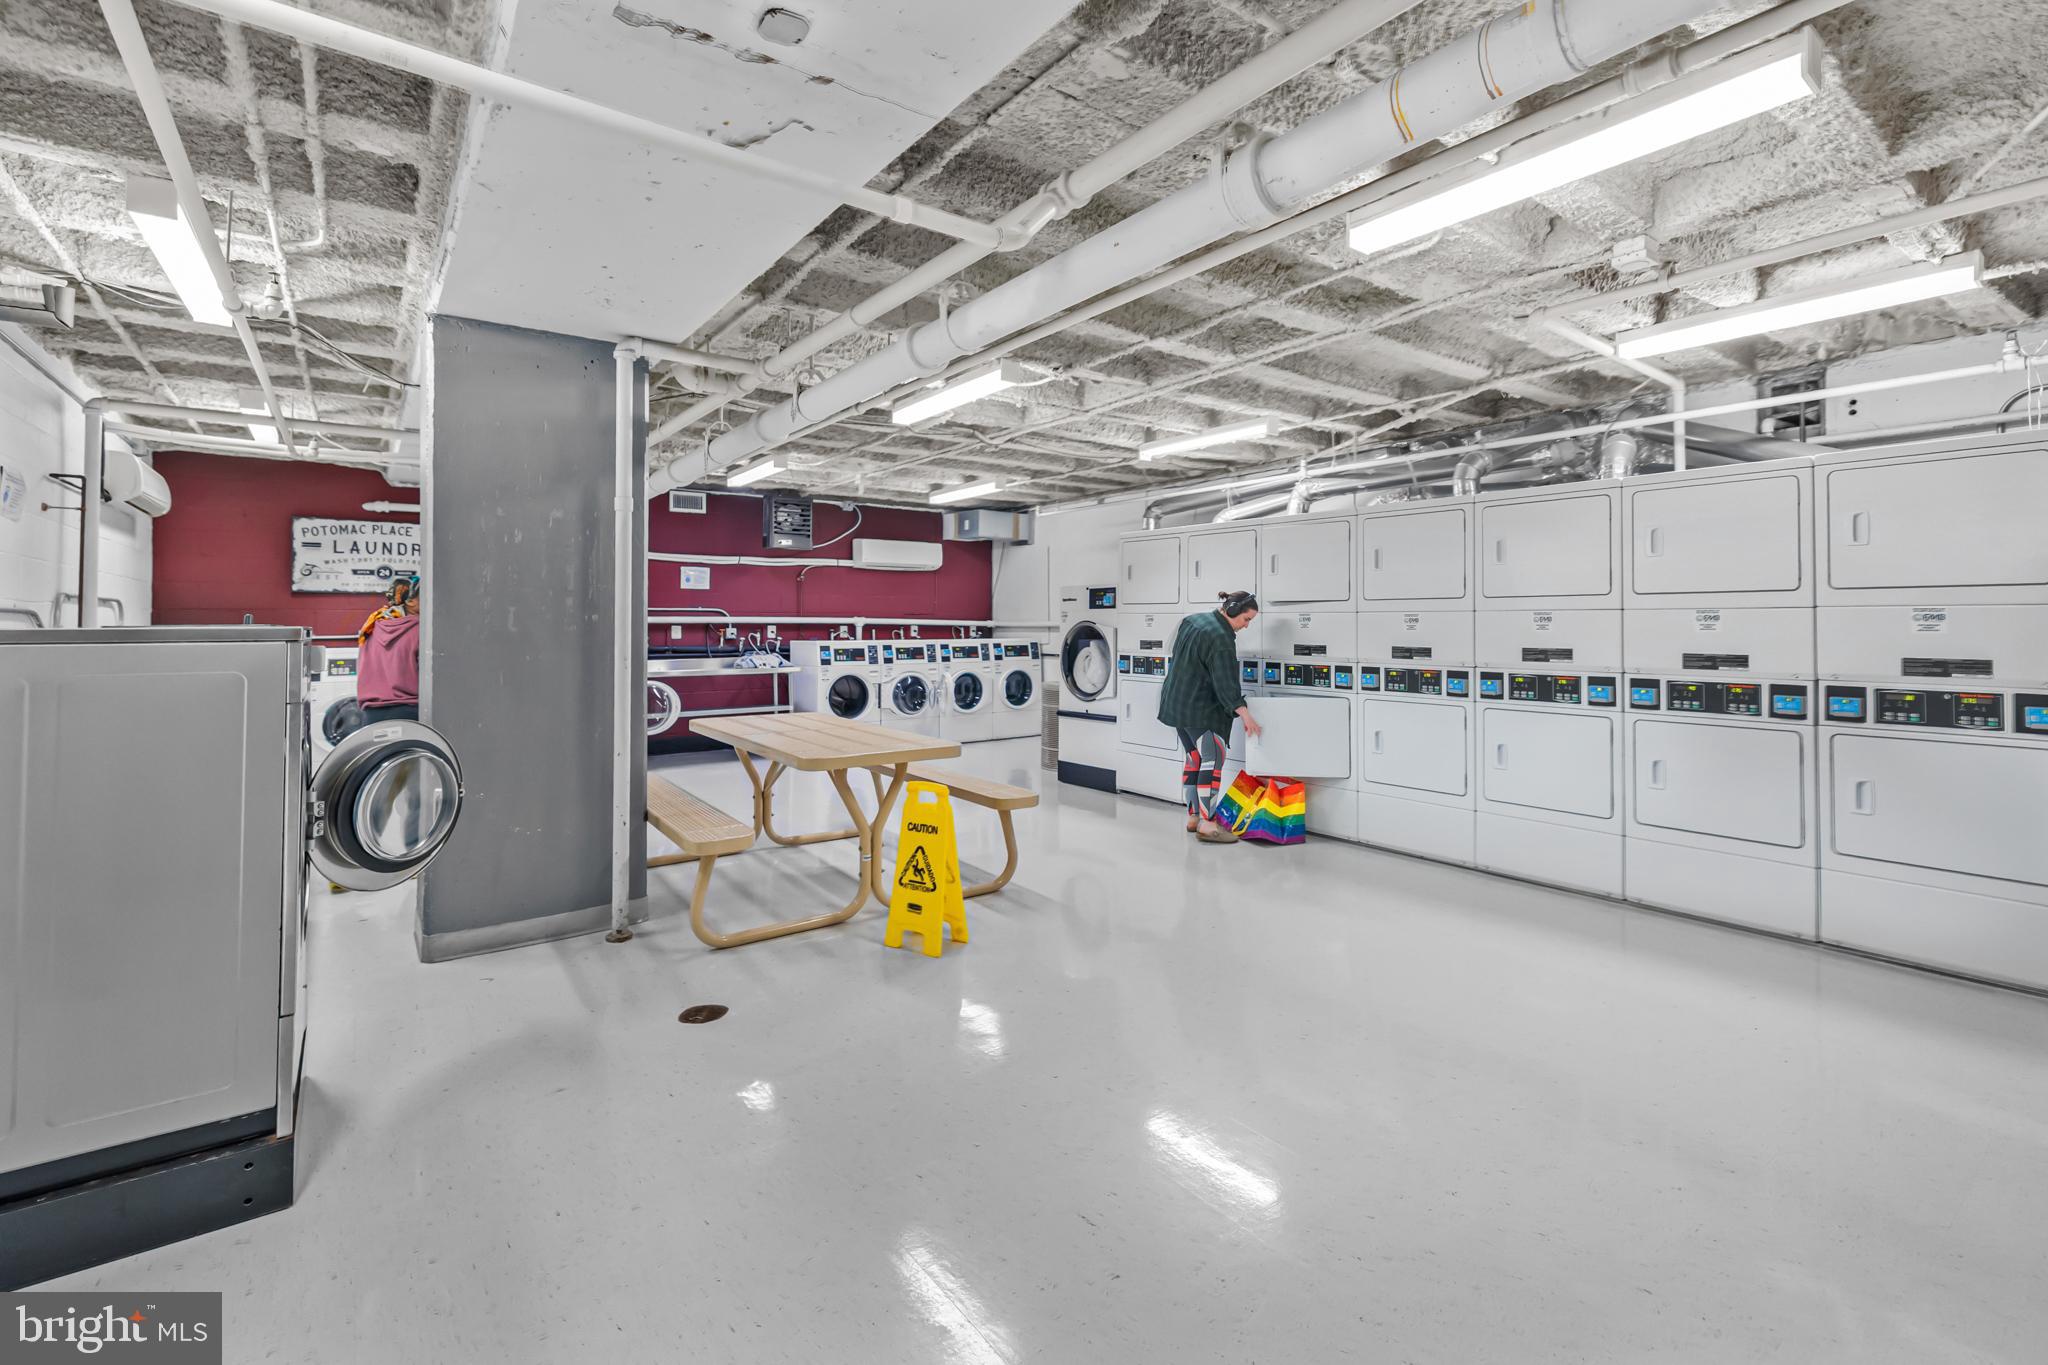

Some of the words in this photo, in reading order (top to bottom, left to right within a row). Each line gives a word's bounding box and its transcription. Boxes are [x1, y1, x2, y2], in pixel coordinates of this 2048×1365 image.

[301, 525, 367, 538] POTOMAC
[372, 524, 413, 537] PLACE
[333, 540, 421, 557] LAUNDR
[378, 568, 390, 577] 24
[907, 822, 939, 835] CAUTION
